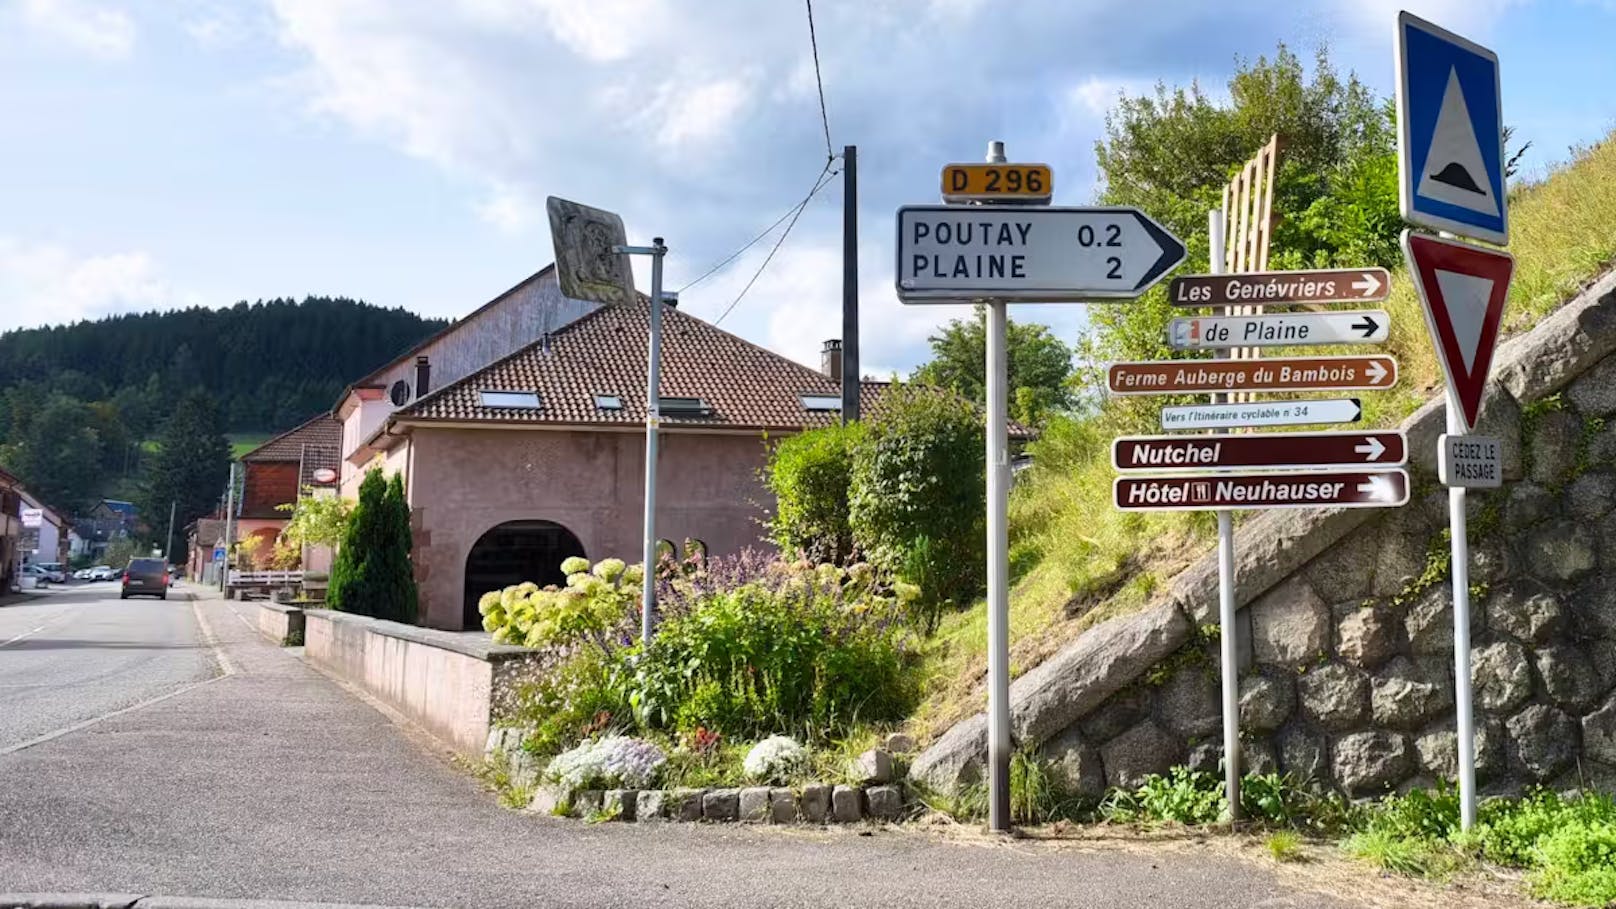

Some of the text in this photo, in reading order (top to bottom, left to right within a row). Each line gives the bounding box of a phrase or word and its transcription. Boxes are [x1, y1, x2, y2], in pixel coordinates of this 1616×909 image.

[952, 169, 1043, 193] D 296
[914, 222, 1122, 247] POUTAY 0.2
[913, 255, 1122, 279] PLAINE 2
[1177, 279, 1336, 302] Les Genévriers
[1205, 320, 1310, 342] de Plaine
[1115, 366, 1356, 388] Ferme Auberge du Bambois
[1165, 412, 1185, 422] Vers
[1241, 409, 1280, 420] cyclable
[1294, 406, 1308, 417] 34
[1132, 443, 1220, 465] Nutchel
[1484, 444, 1495, 460] LE
[1455, 461, 1495, 480] PASSAGE
[1128, 480, 1344, 504] Hôtel Neuhauser
